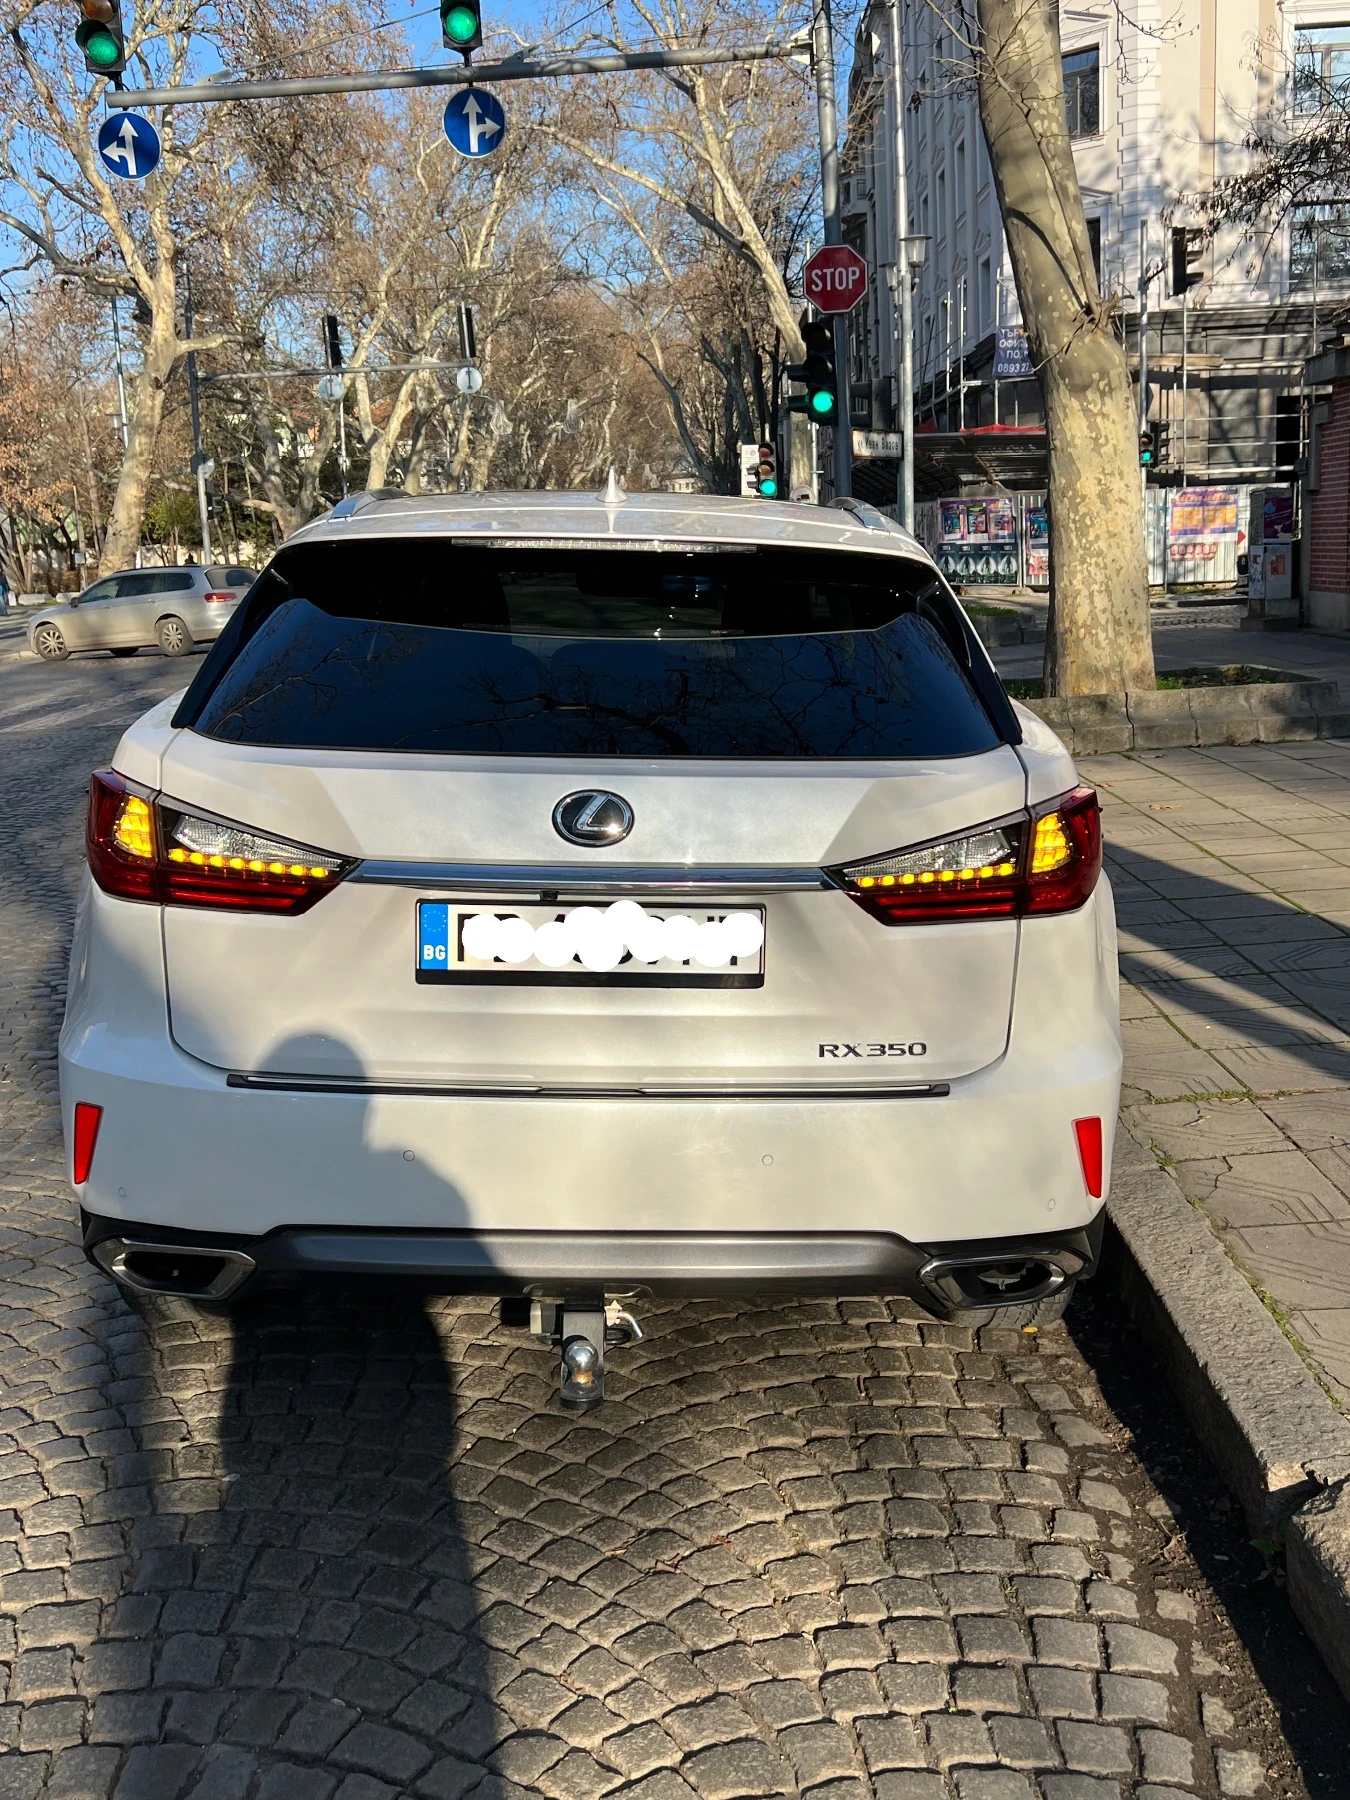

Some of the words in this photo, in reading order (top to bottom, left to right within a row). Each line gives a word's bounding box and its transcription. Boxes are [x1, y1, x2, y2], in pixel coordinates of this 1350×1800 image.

[811, 266, 860, 292] STOP
[998, 363, 1020, 373] 0893
[423, 945, 446, 960] BG
